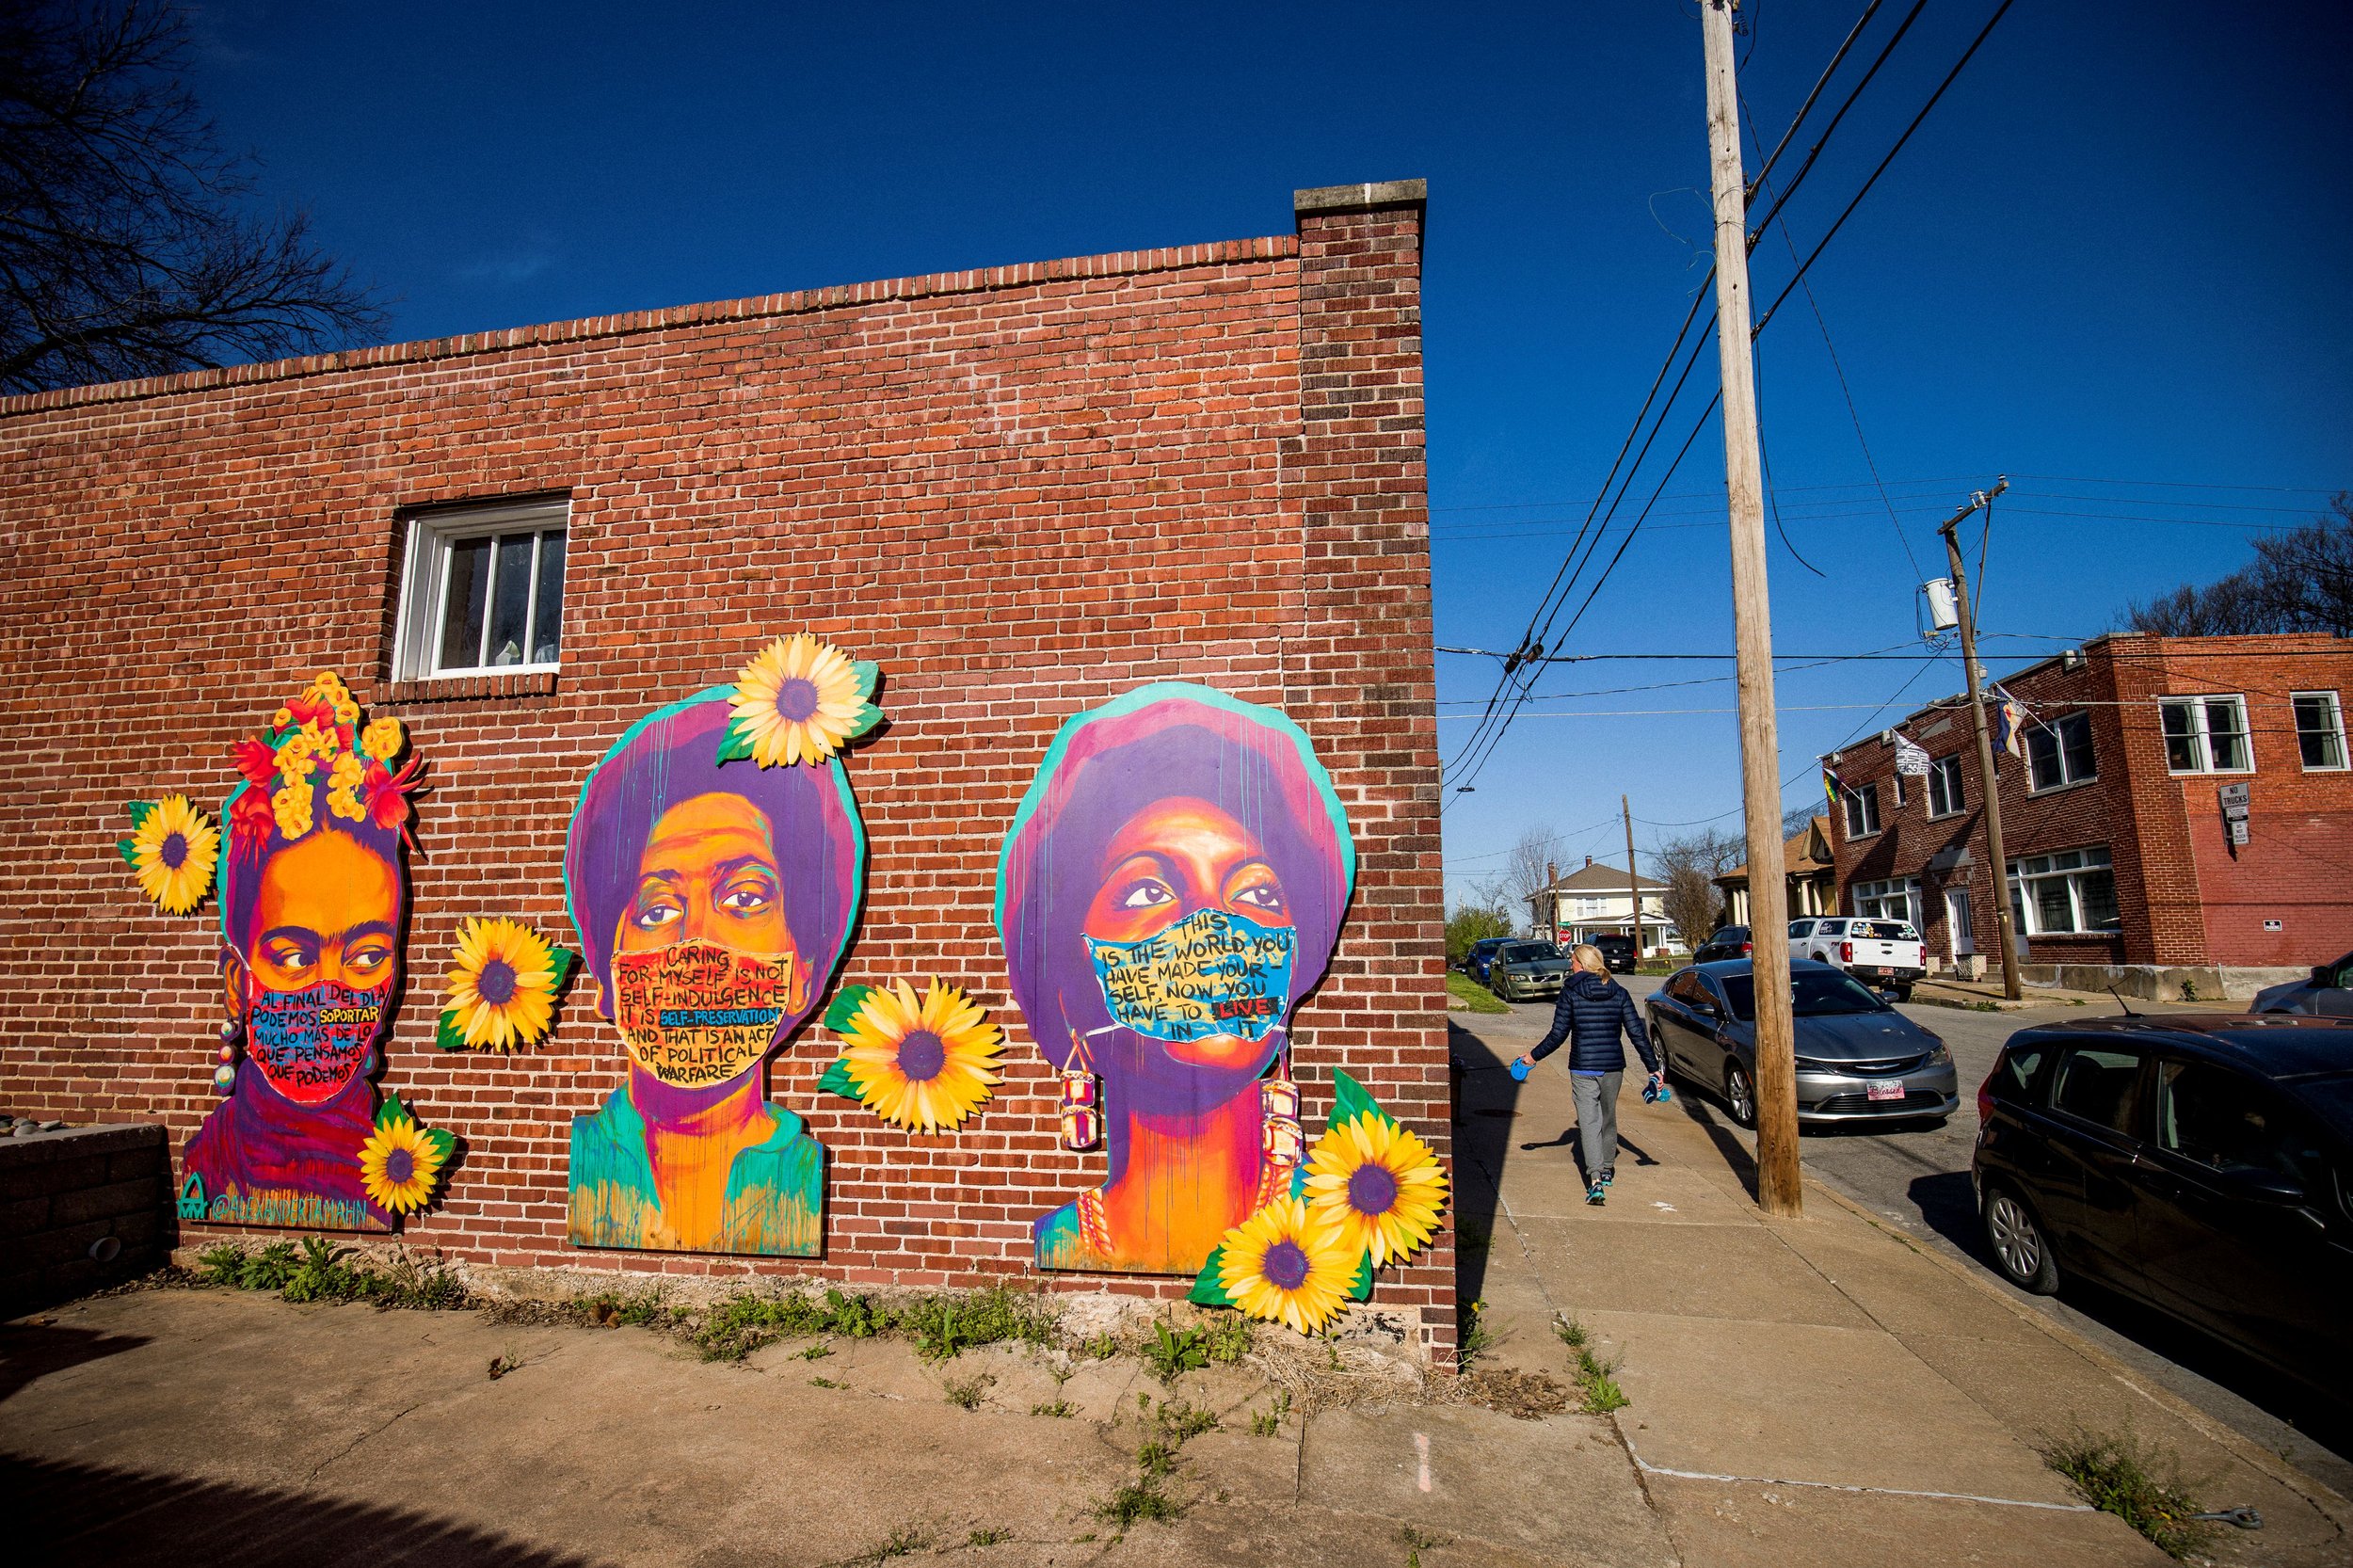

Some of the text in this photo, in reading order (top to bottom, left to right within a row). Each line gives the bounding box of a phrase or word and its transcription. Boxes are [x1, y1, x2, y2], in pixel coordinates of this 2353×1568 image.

[2223, 794, 2248, 806] TRUCKS
[2230, 786, 2238, 794] NO
[1180, 914, 1227, 939] THIS
[666, 945, 729, 971] CARING
[1102, 931, 1290, 969] IS THE WORLD YOU
[619, 957, 788, 989] FOR MYSELF IS NOT
[1104, 966, 1149, 988] HAVE
[1158, 961, 1211, 982] MADE
[261, 991, 277, 1009] AL
[283, 992, 327, 1010] FINAL
[329, 984, 358, 1005] DEL
[1166, 981, 1213, 1000] NOW
[1223, 980, 1267, 1000] YOU
[251, 1006, 380, 1027] PODEMOS SOPORTAR
[620, 1004, 780, 1026] IT IS SELF-PRESERVATION
[1117, 999, 1272, 1024] HAVE TO LIVE
[254, 1031, 298, 1047] MUCHO
[336, 1028, 351, 1042] DE
[357, 1026, 372, 1042] LO
[628, 1026, 776, 1046] AND THAT IS AN ACT
[1171, 1022, 1193, 1041] IN
[257, 1043, 363, 1063] QUE PENSAMOS
[640, 1045, 760, 1064] OF POLITICAL
[267, 1063, 352, 1087] QUE PODEMOS
[212, 1193, 367, 1225] @ALEXANDERTAMAHN
